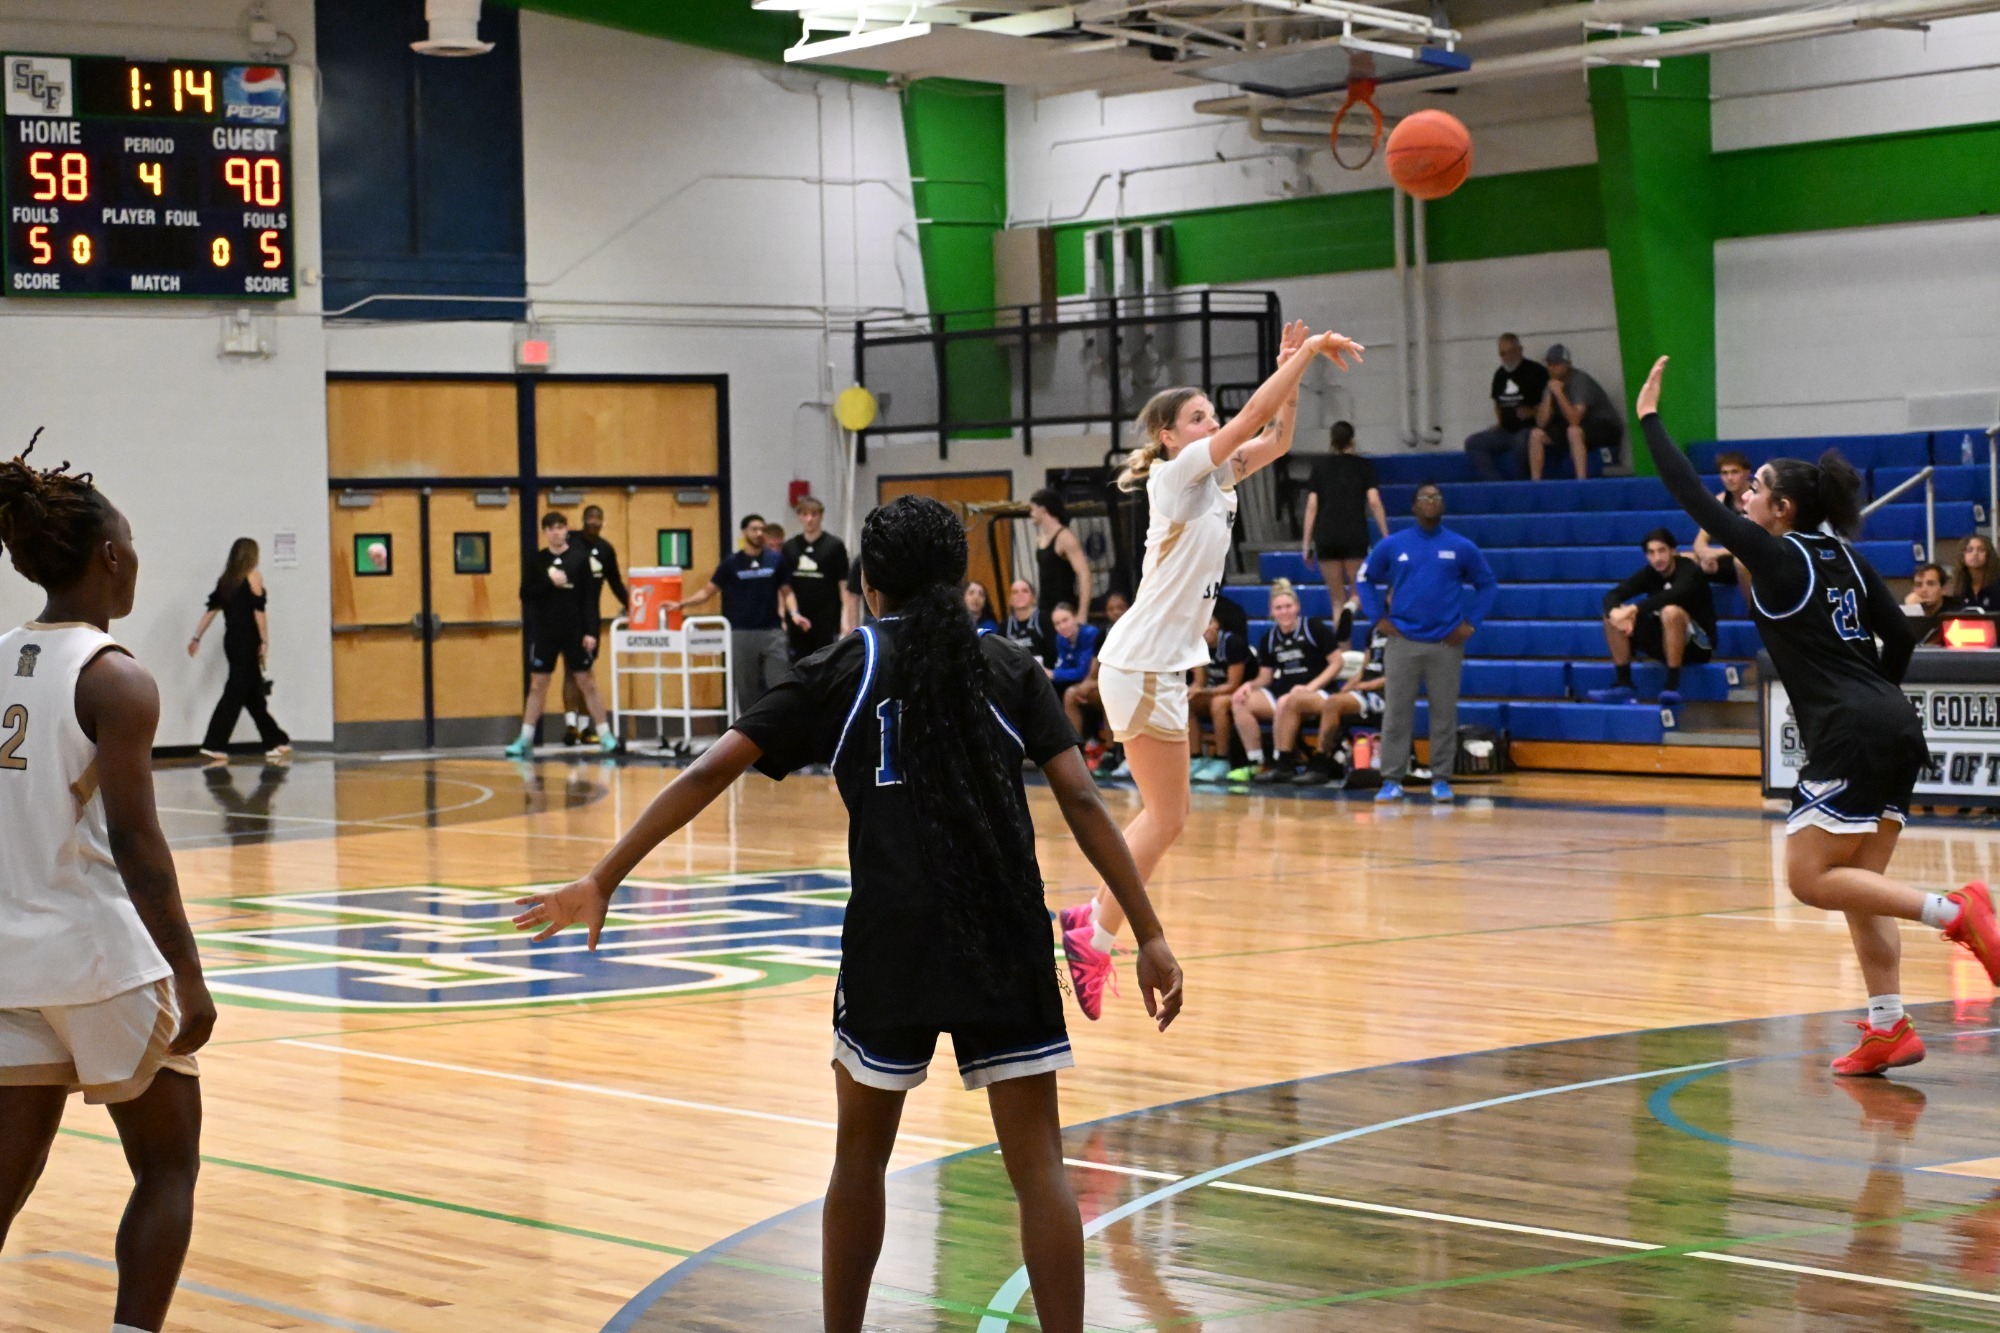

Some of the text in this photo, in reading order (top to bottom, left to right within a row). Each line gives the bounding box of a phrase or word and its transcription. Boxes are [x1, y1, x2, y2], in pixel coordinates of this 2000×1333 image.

[225, 104, 282, 119] PEPSI
[20, 120, 82, 144] HOME
[212, 127, 278, 151] GUEST
[124, 137, 175, 153] PERIOD
[29, 152, 88, 201] 58
[139, 162, 162, 196] 4
[225, 157, 281, 207] 90
[12, 206, 60, 223] FOULS
[102, 208, 201, 227] PLAYER FOUL
[243, 212, 288, 229] FOULS
[29, 226, 52, 264] 5
[72, 234, 91, 264] 0
[212, 237, 230, 267] 0
[260, 231, 281, 269] 5
[13, 272, 60, 290] SCORE
[131, 275, 181, 292] MATCH
[244, 276, 290, 293] SCORE
[1827, 588, 1871, 641] 21
[627, 636, 670, 648] GATORADE
[1951, 755, 1983, 782] OF
